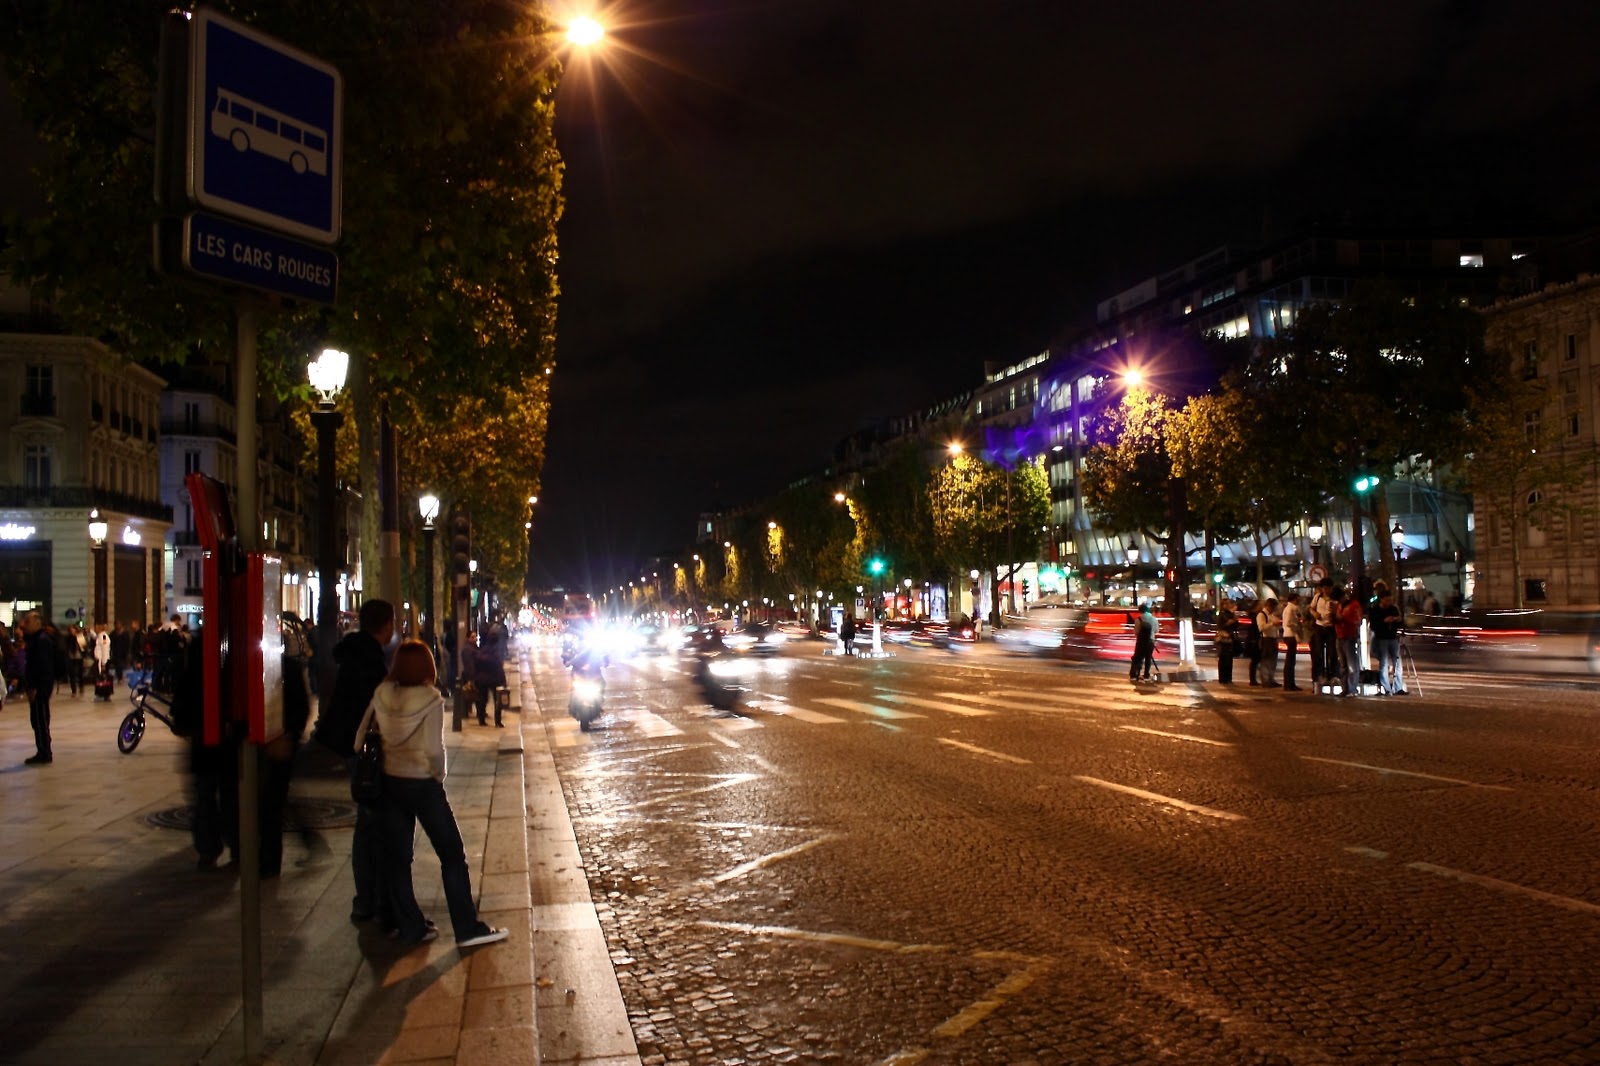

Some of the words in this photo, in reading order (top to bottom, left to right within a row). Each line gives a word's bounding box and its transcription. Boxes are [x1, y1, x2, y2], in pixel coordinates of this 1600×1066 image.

[197, 232, 226, 258] LES
[232, 241, 273, 271] CARS
[278, 255, 331, 288] ROUGES
